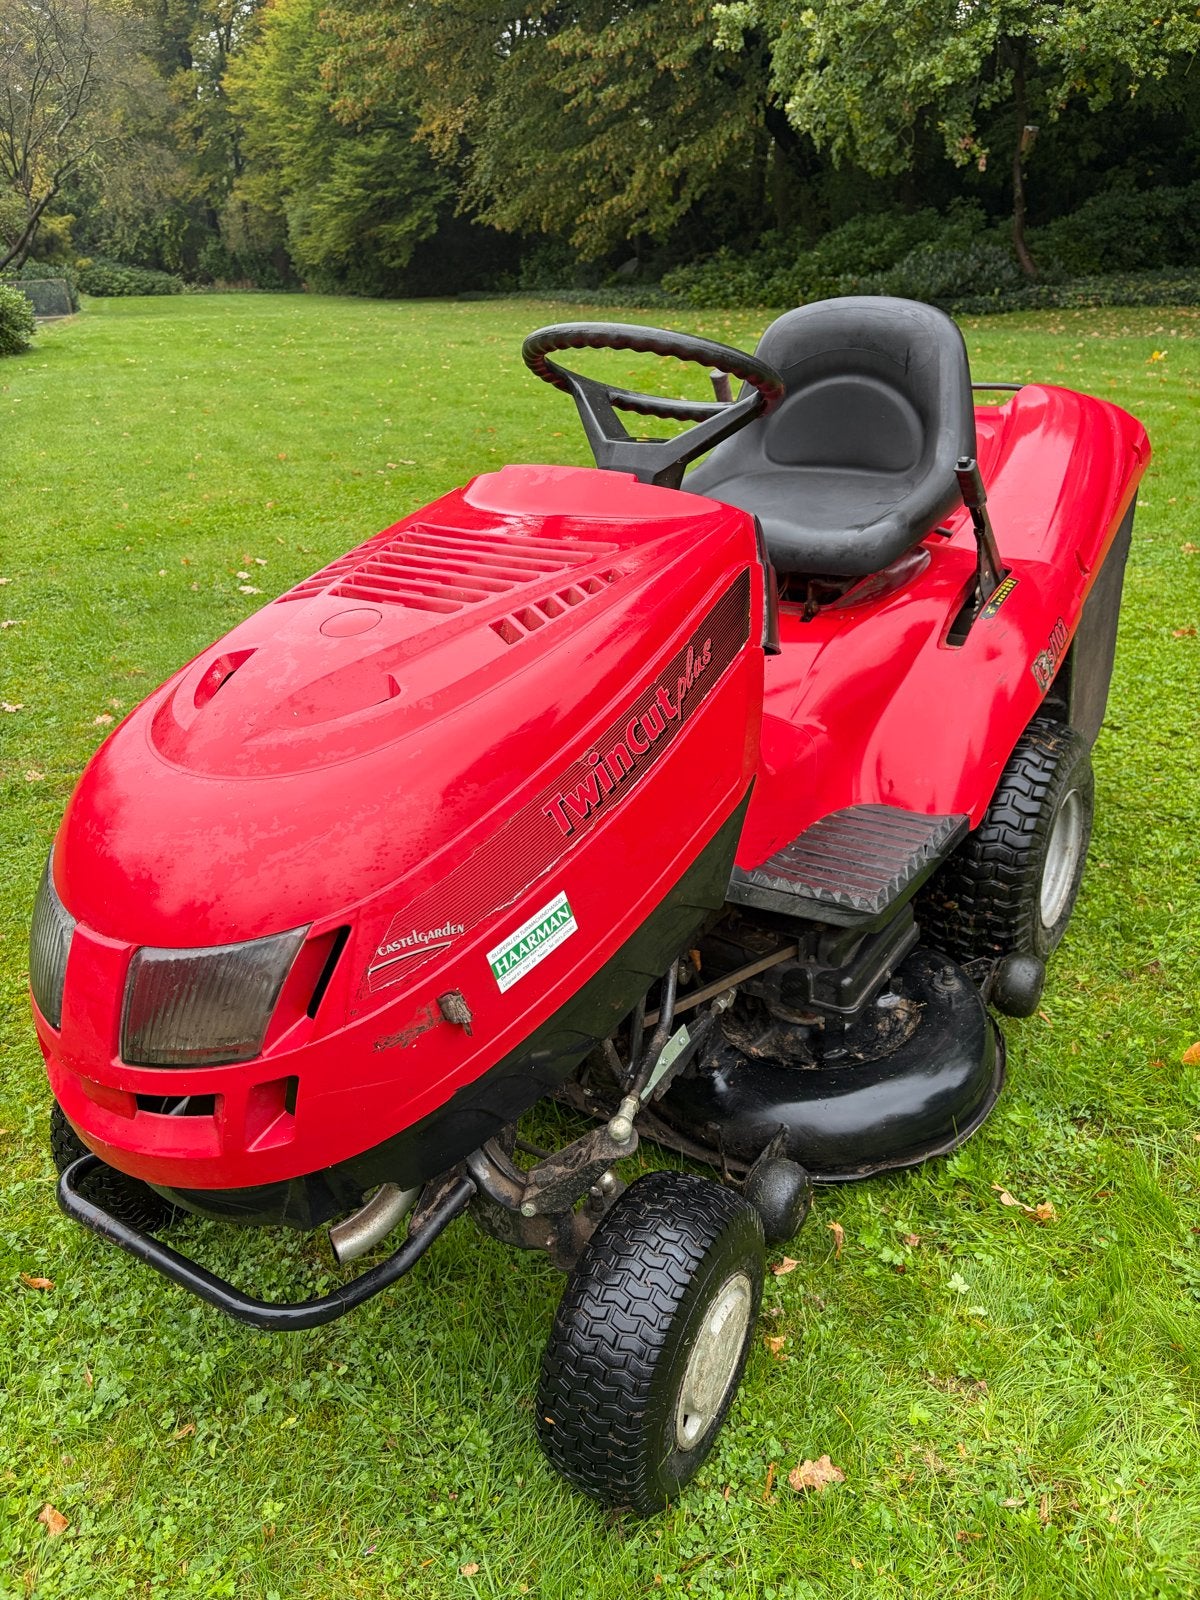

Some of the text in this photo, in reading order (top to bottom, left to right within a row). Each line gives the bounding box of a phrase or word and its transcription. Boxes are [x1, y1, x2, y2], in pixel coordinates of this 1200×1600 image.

[541, 638, 713, 837] TwinCut plus
[494, 904, 570, 976] HAARMAN
